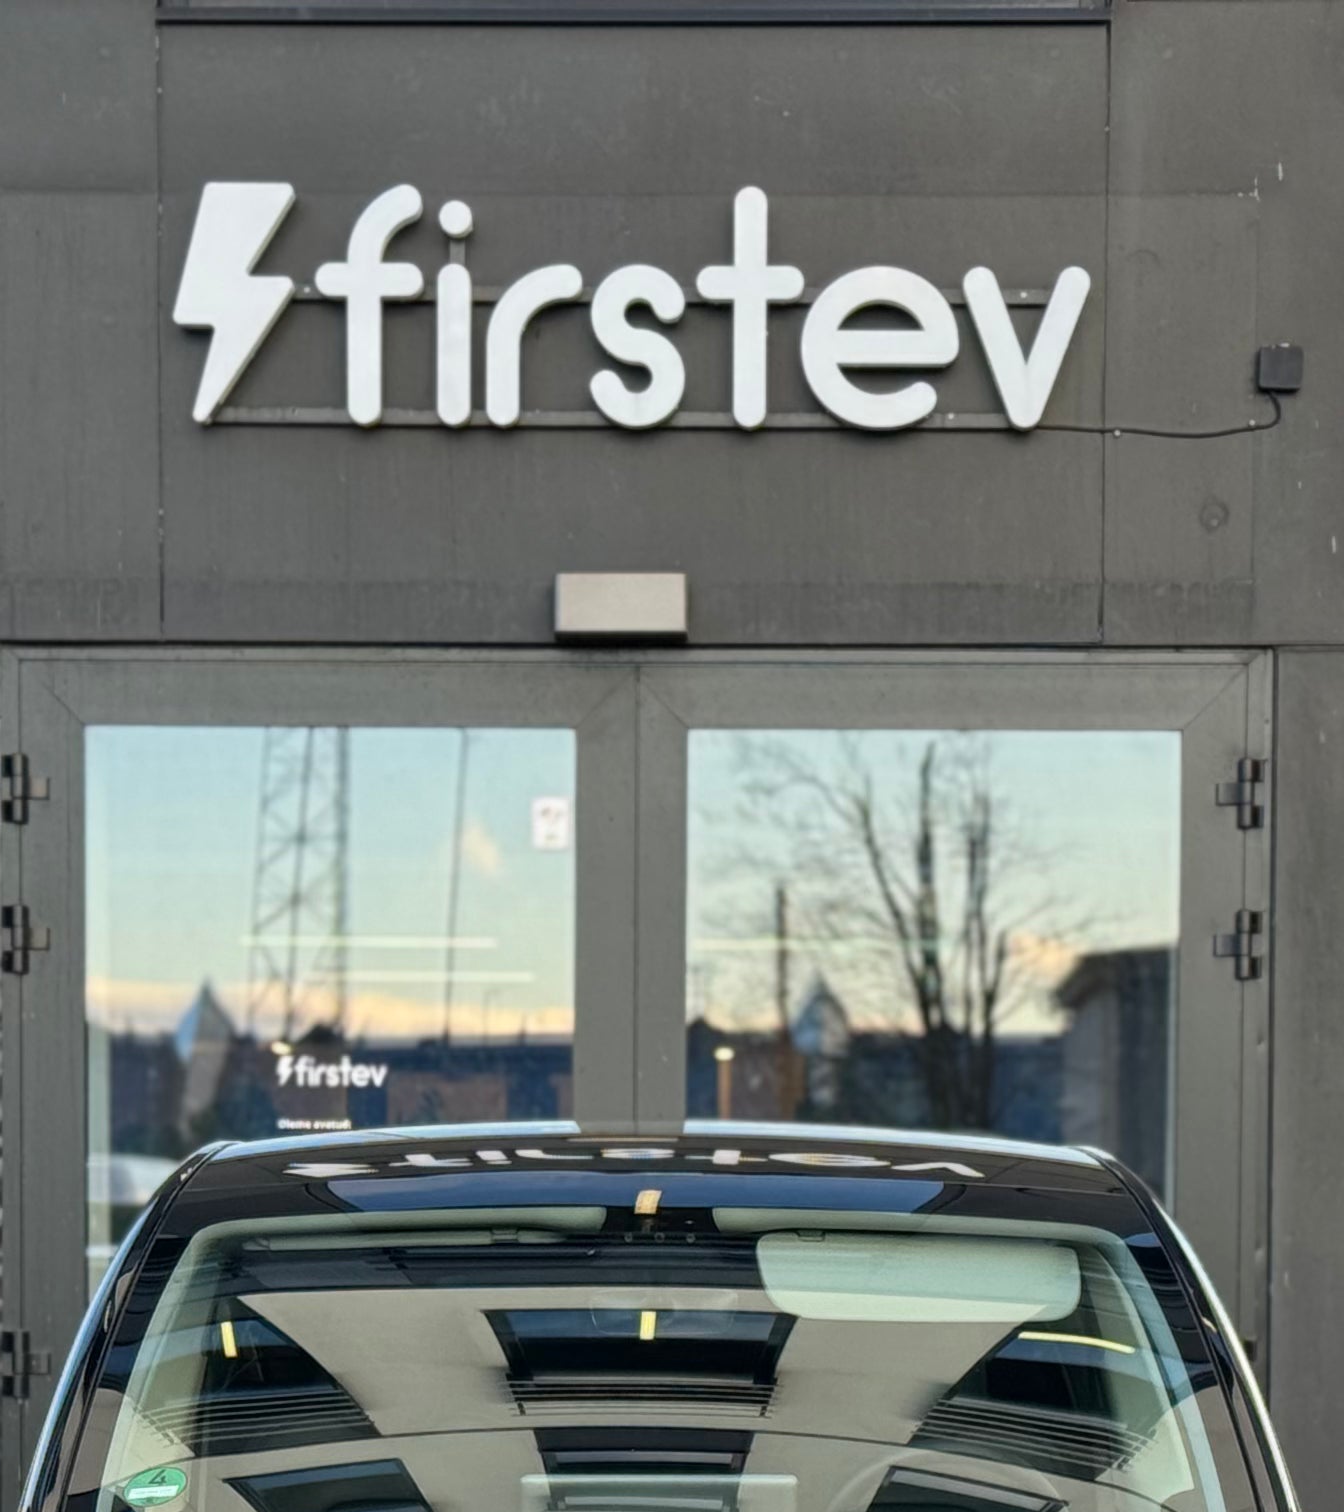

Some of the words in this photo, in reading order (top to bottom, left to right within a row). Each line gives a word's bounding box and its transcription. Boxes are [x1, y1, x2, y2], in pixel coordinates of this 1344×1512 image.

[314, 185, 1092, 431] firstev
[294, 1055, 388, 1088] firstev
[147, 1468, 168, 1486] 4
